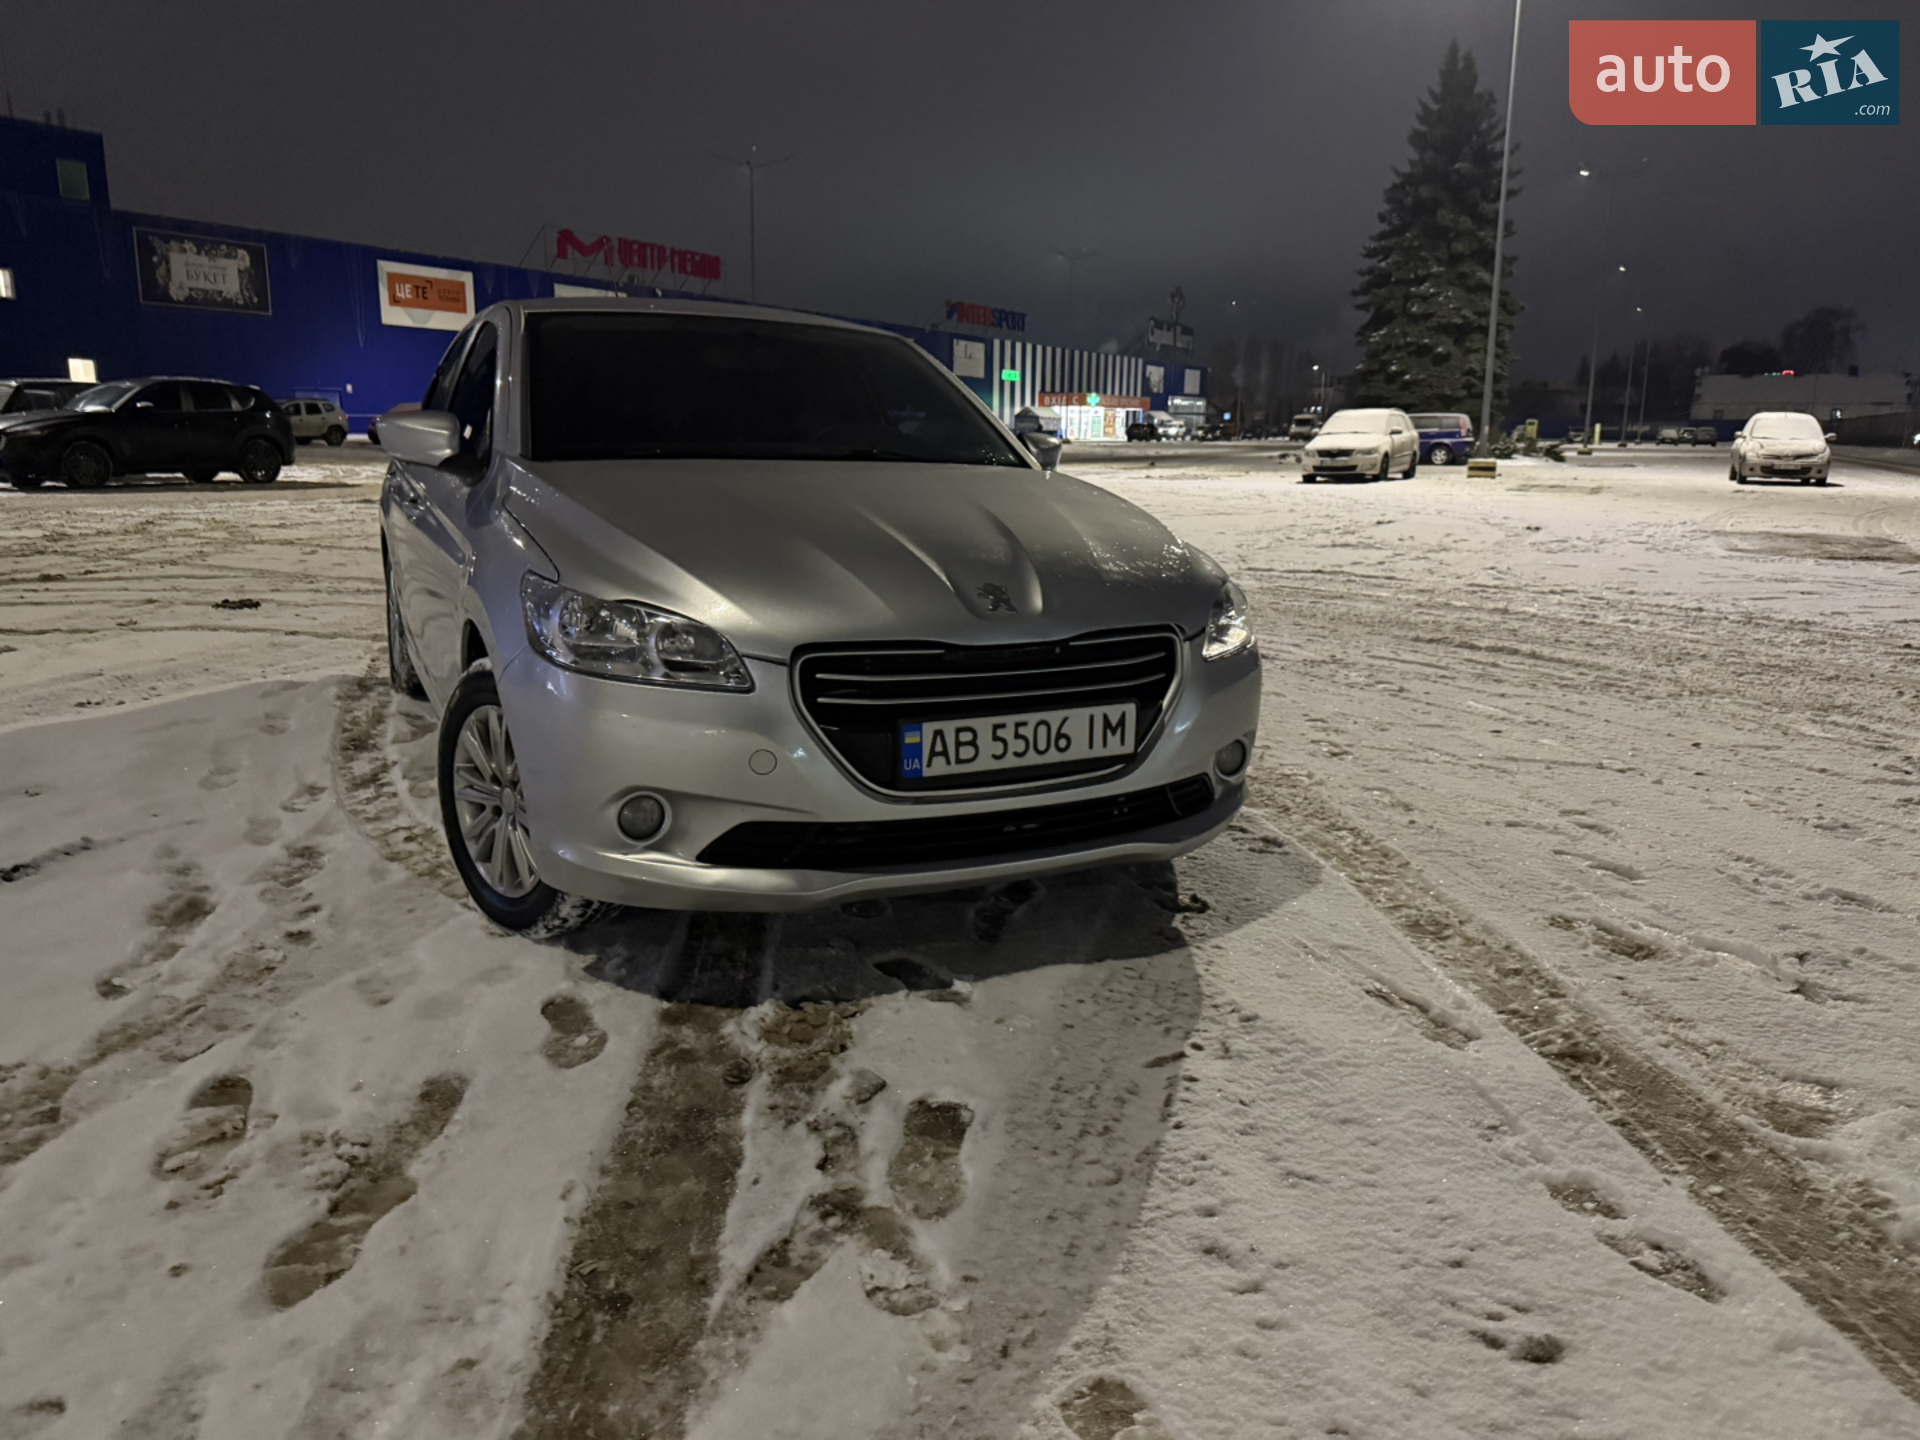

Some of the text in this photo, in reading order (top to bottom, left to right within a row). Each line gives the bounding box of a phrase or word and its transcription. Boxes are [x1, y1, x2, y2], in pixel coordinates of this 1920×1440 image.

[926, 710, 1127, 769] AB 5506 IM
[904, 758, 921, 771] UA
